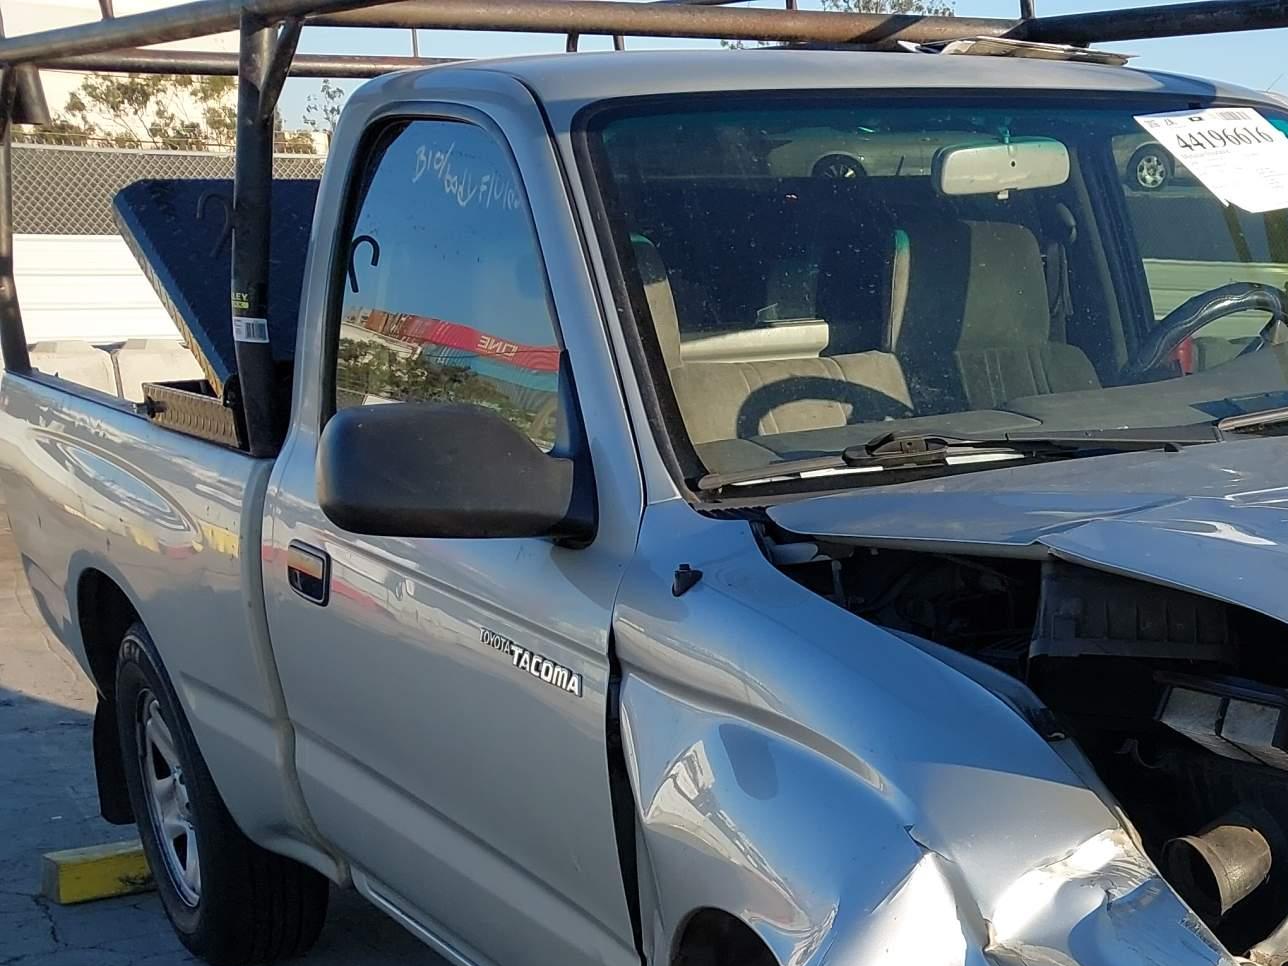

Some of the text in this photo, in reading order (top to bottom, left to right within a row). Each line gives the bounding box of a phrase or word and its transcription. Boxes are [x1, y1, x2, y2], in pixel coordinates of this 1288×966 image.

[1175, 127, 1274, 151] 44196616
[479, 627, 582, 696] TOYOTA TACOMA
